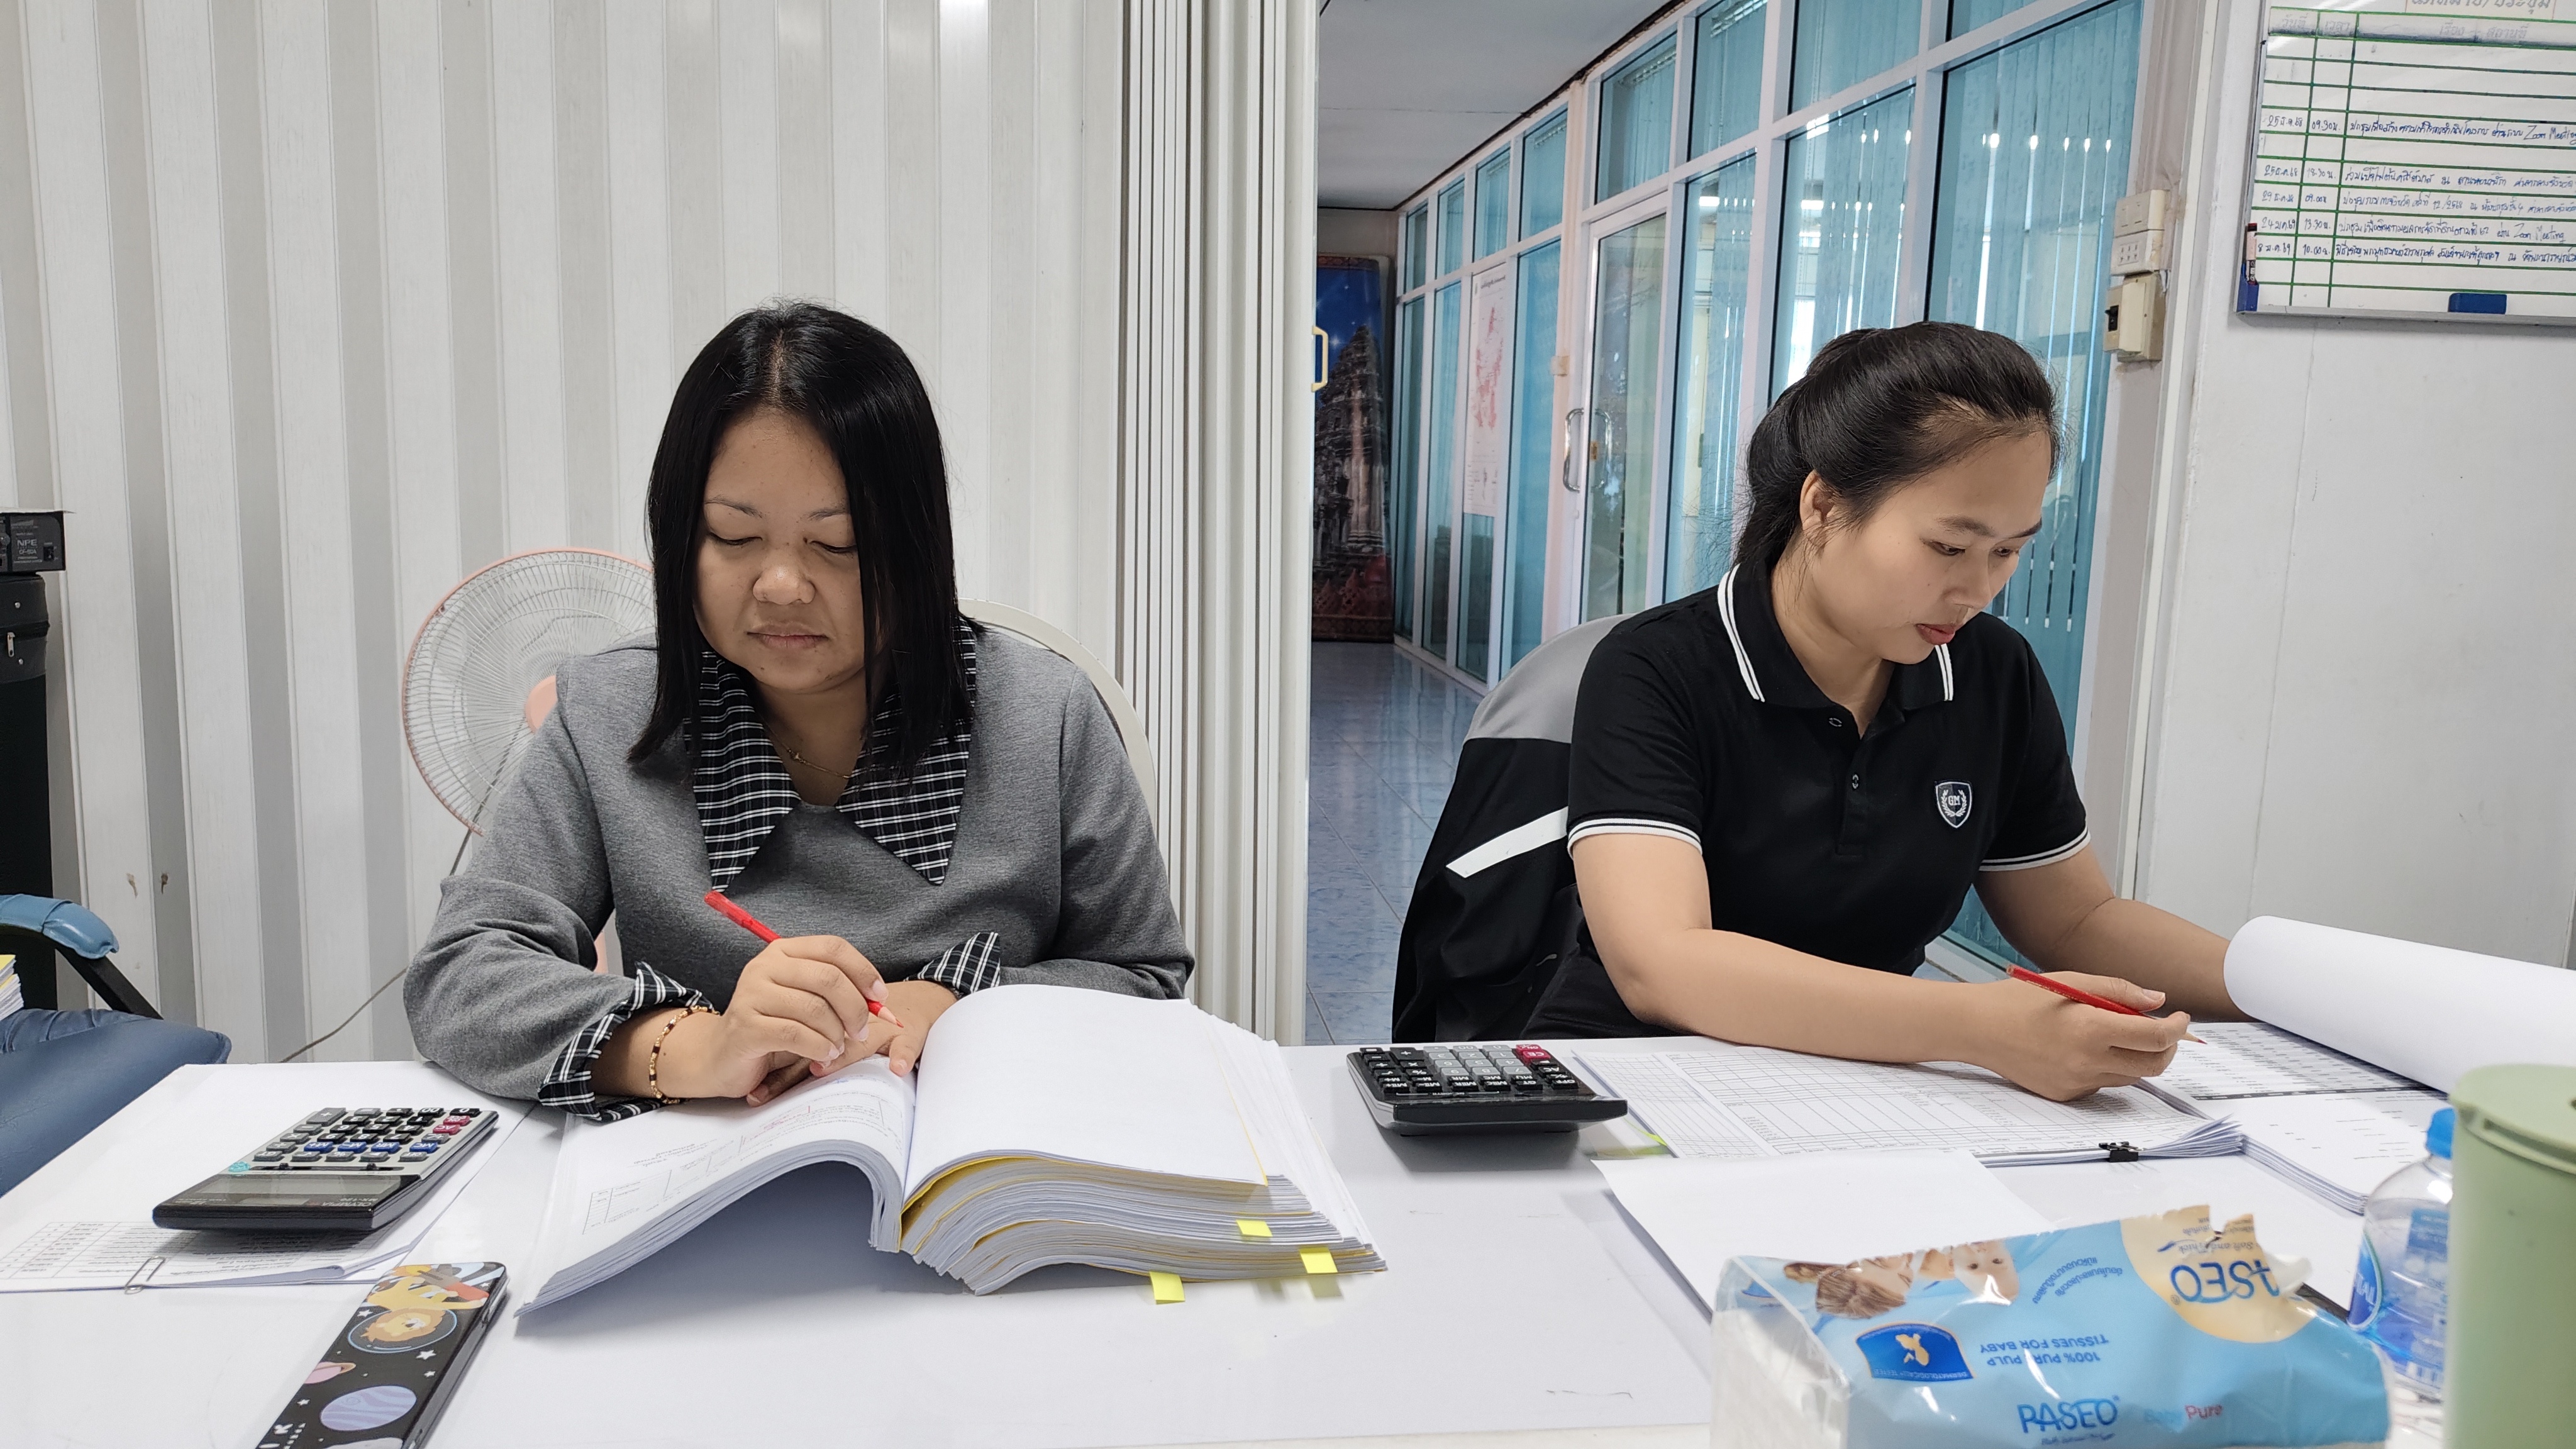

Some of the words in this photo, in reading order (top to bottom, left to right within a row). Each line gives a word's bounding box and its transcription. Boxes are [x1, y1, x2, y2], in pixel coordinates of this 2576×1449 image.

[2282, 13, 2309, 29] วันที่
[2324, 20, 2351, 32] เวลา
[2486, 23, 2530, 39] สถานที่
[2523, 125, 2546, 140] Zoom
[1948, 796, 1961, 806] GM
[2168, 1260, 2280, 1304] ASEO
[1980, 1341, 2017, 1353] BABY
[2019, 1339, 2050, 1350] FOR
[2051, 1334, 2109, 1348] TISSUES
[1987, 1355, 2023, 1366] PULP
[2033, 1353, 2062, 1365] PUR
[2063, 1352, 2101, 1363] 100%
[2017, 1398, 2118, 1434] PASEO
